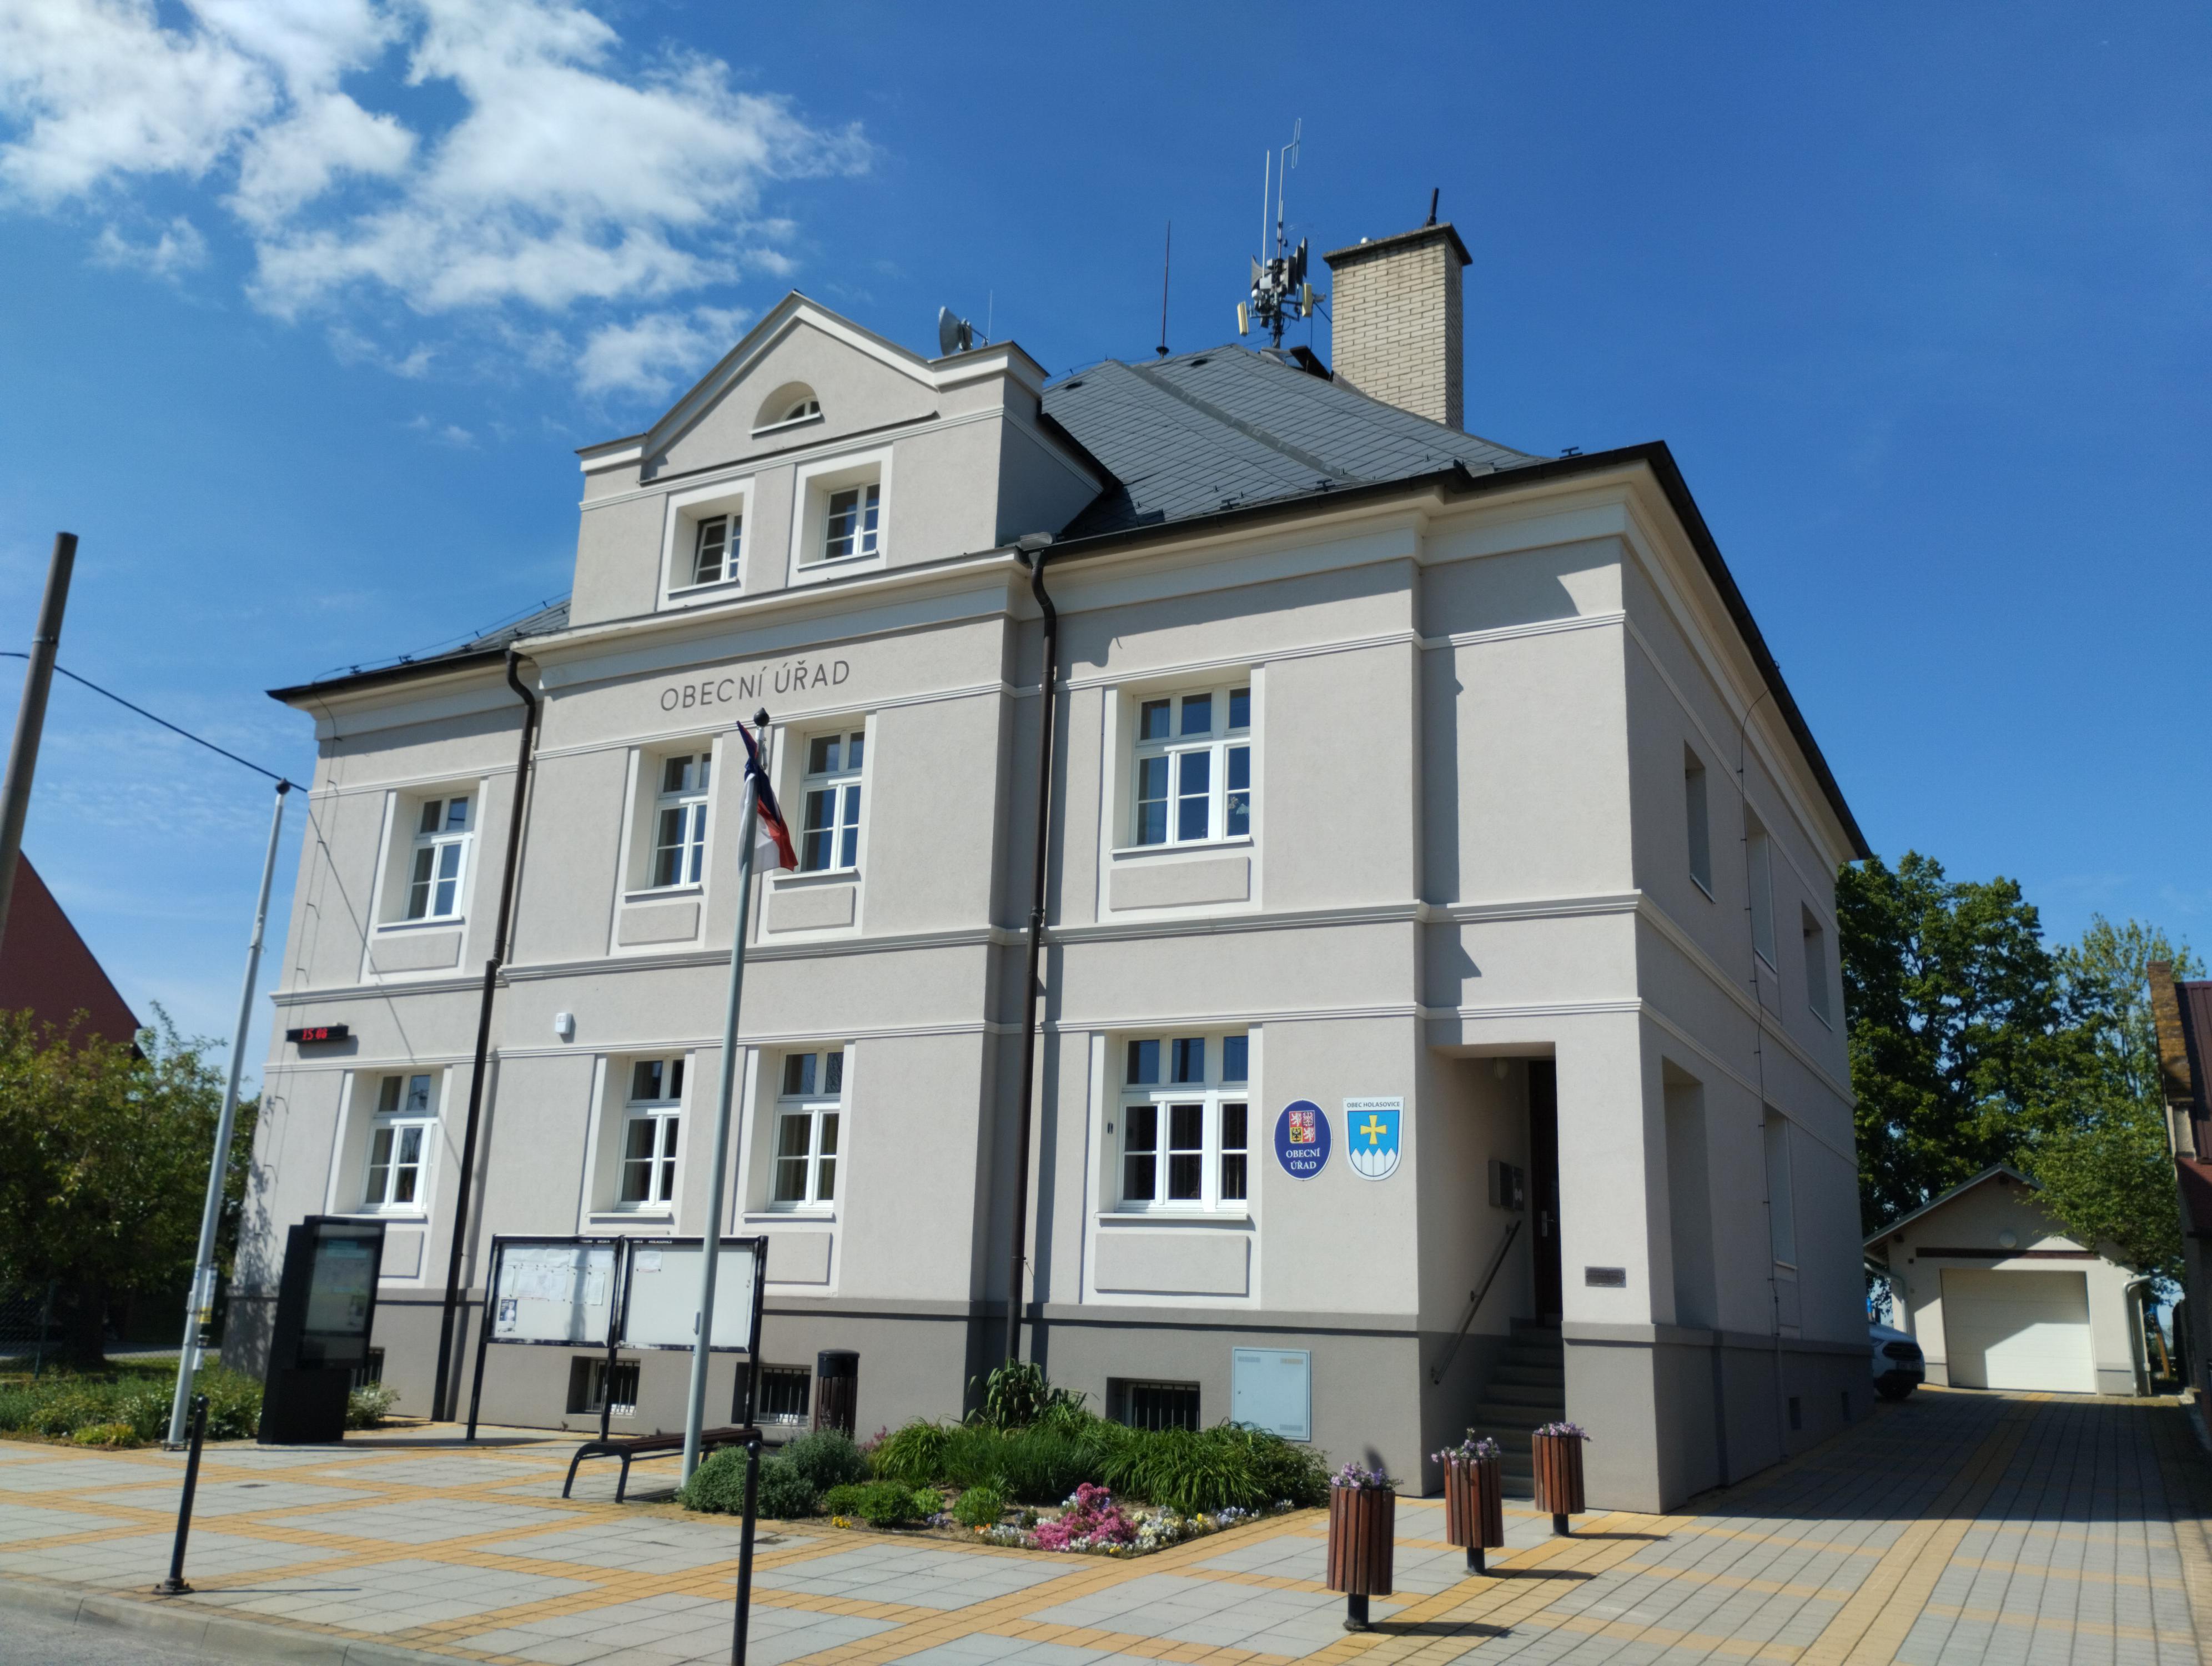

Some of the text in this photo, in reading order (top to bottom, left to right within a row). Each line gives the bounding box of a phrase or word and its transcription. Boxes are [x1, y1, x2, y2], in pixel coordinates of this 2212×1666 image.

[661, 660, 850, 711] OBECNÍ ÚŘAD
[1285, 1147, 1321, 1158] OBECNÍ
[1290, 1160, 1316, 1170] ÚŘAD
